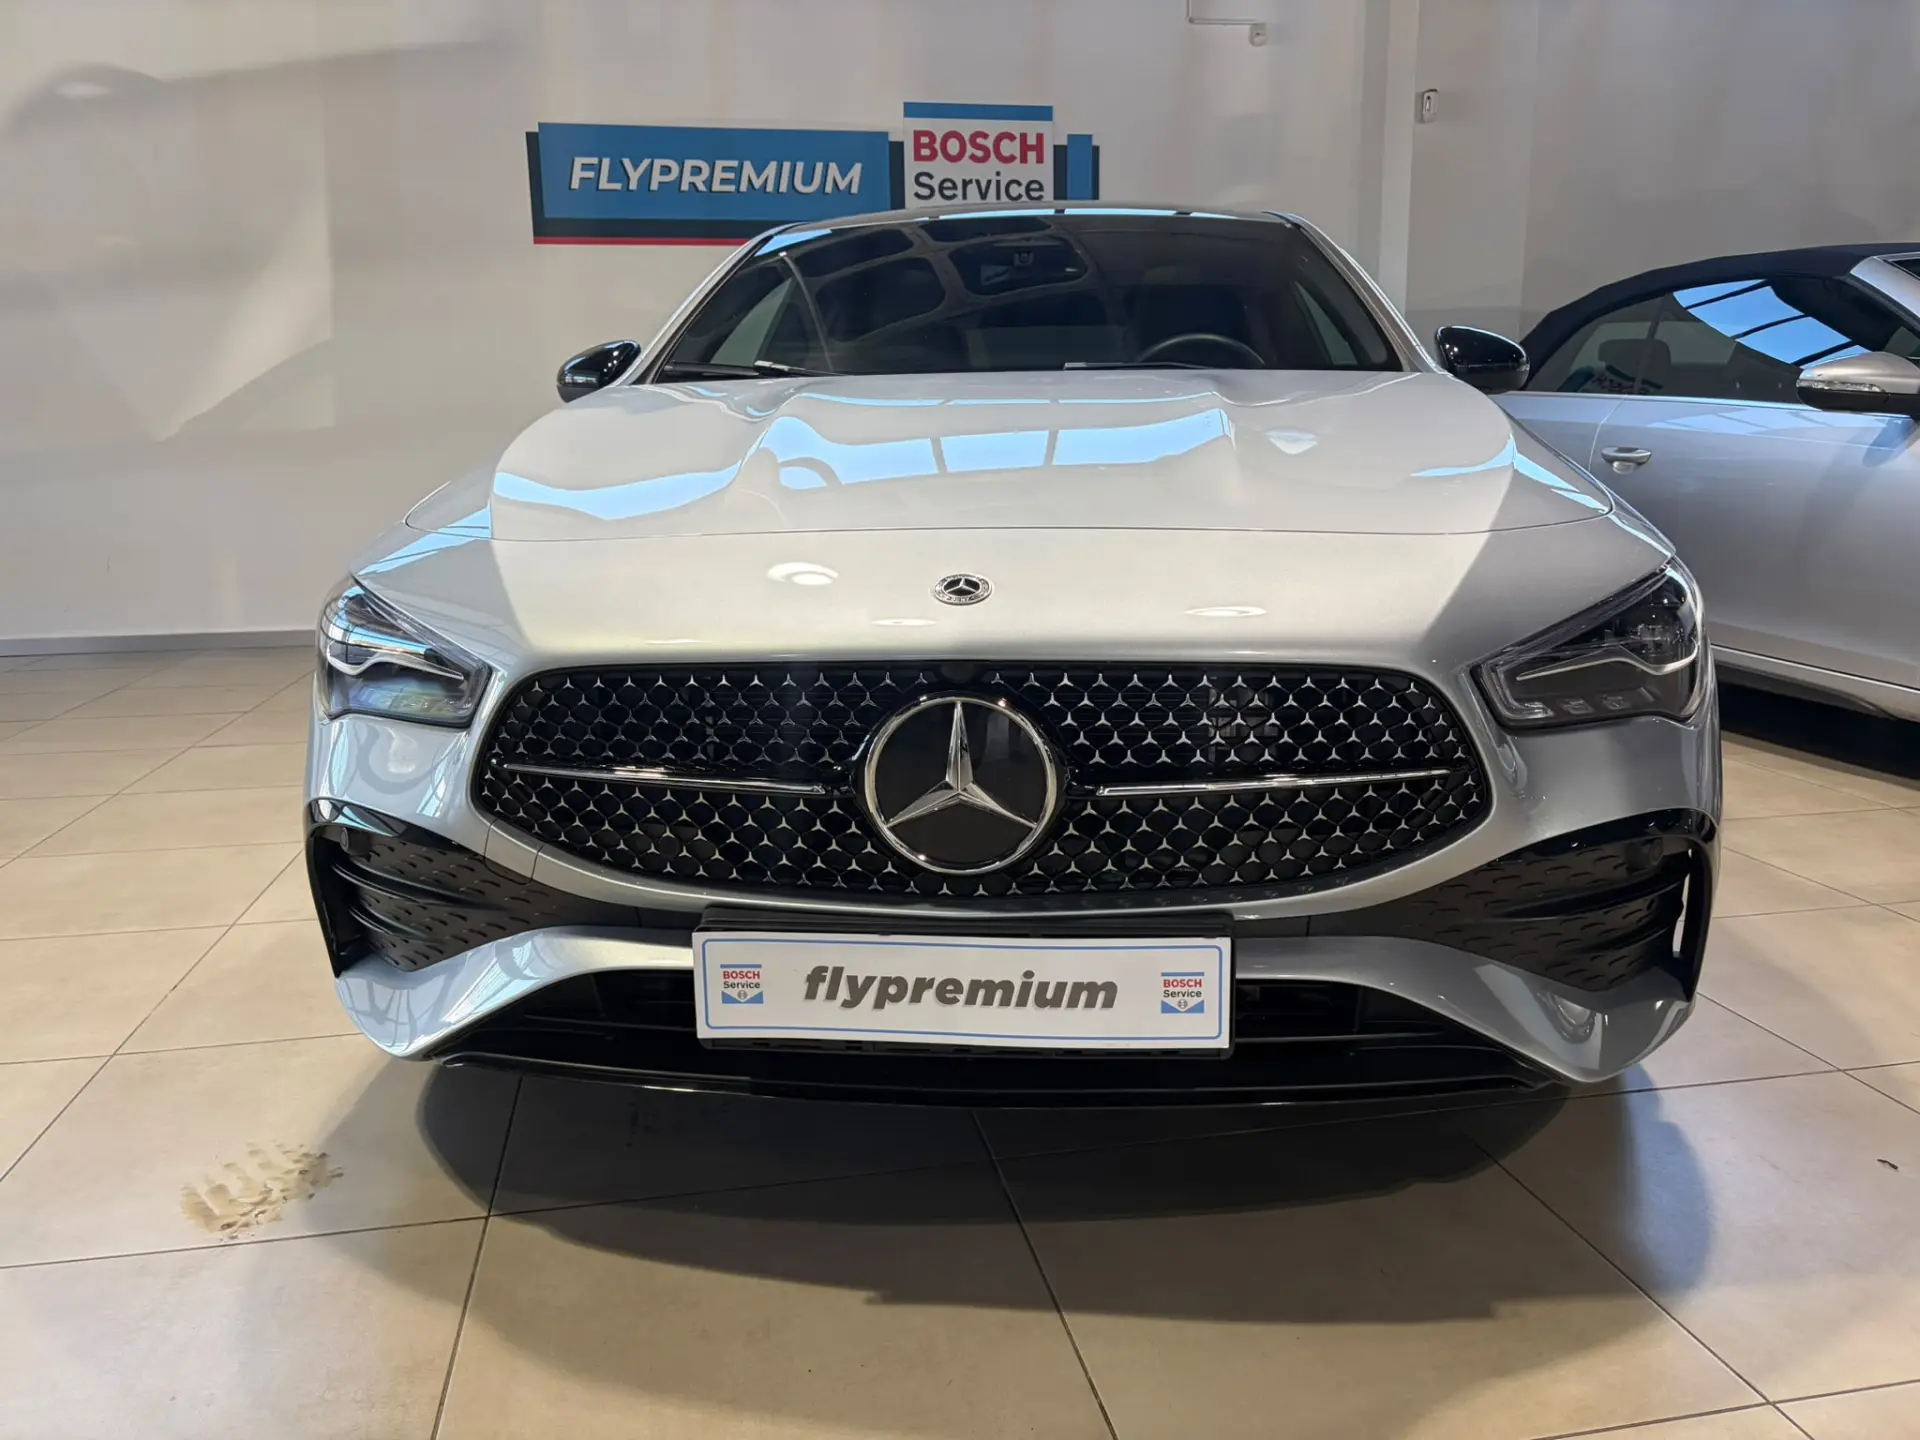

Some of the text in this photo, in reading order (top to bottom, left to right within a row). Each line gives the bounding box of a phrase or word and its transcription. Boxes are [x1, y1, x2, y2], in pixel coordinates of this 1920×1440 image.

[913, 129, 1045, 165] BOSCH
[569, 156, 863, 195] FLYPREMIUM
[913, 171, 1045, 202] Service
[722, 970, 761, 980] BOSCH
[723, 980, 761, 989] Service
[1163, 978, 1203, 988] BOSCH
[803, 965, 1118, 1010] flypremium
[1163, 988, 1202, 998] Service
